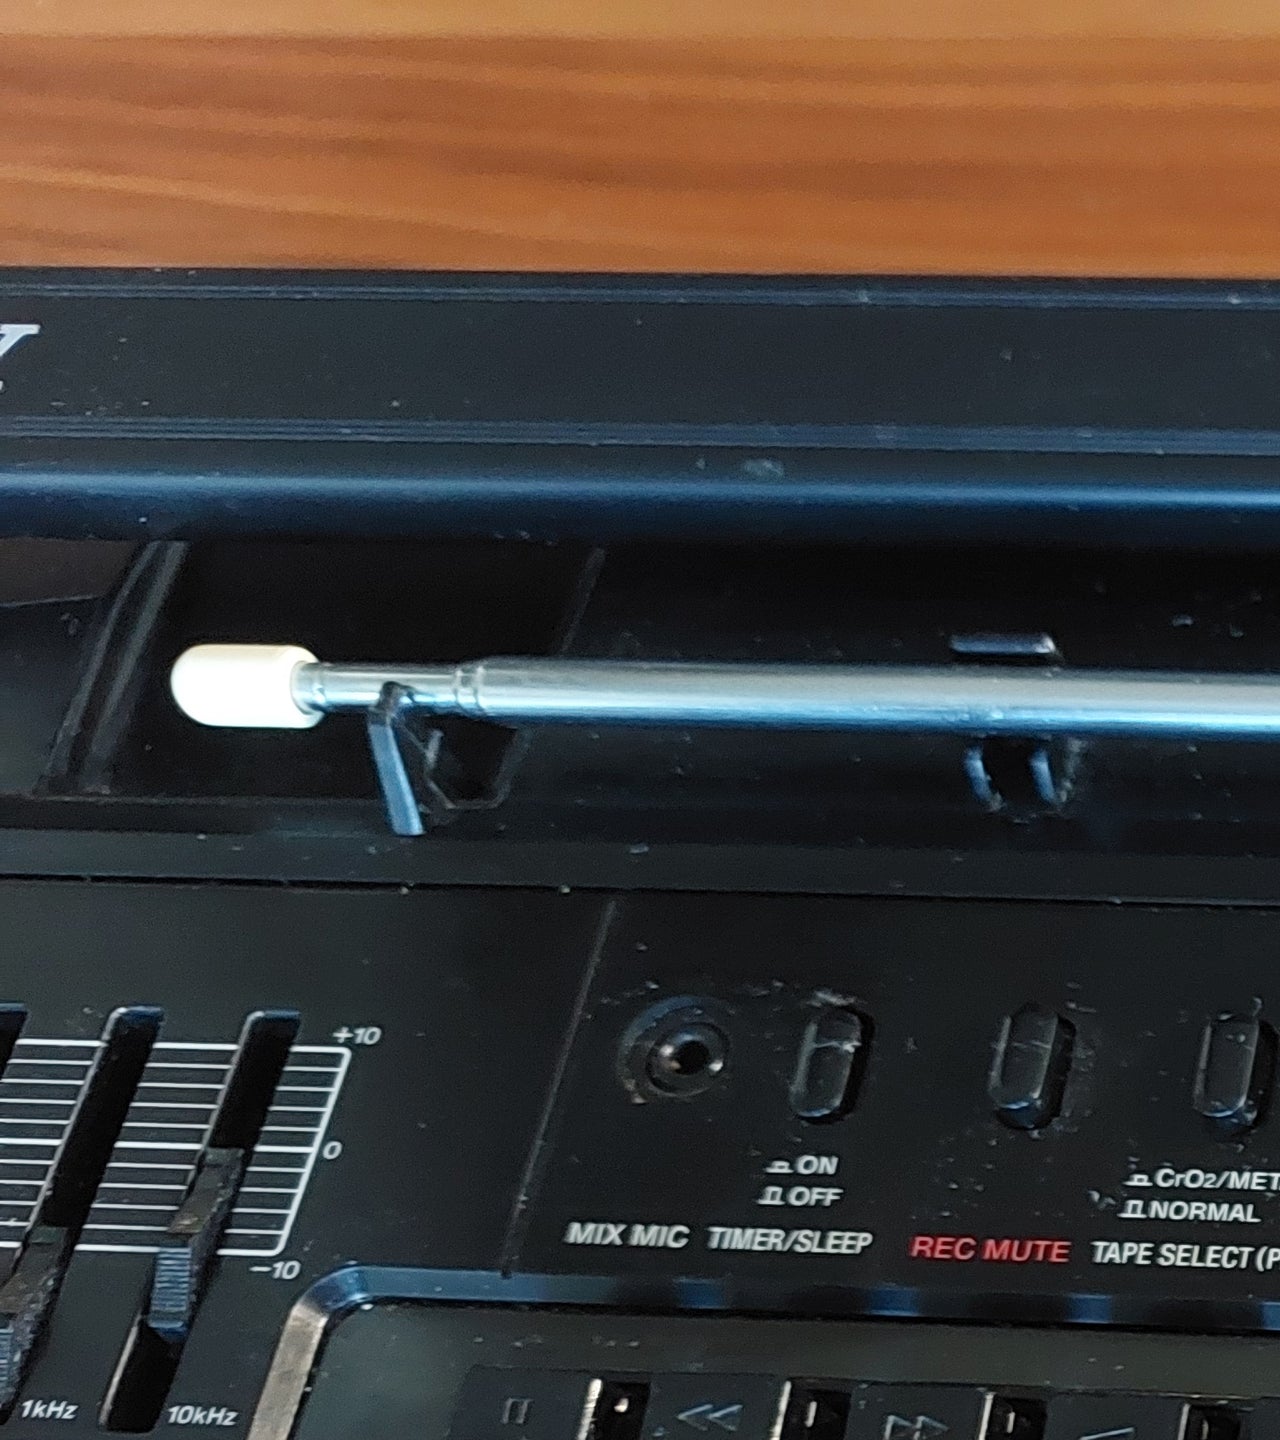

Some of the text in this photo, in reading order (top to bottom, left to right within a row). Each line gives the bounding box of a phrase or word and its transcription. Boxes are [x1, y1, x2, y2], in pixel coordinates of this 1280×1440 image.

[333, 1027, 381, 1045] +10
[322, 1141, 342, 1160] 0
[798, 1156, 838, 1175] ON
[786, 1187, 843, 1207] OFF
[1148, 1201, 1261, 1223] NORMAL
[565, 1222, 690, 1249] MIX MIC
[706, 1227, 873, 1255] TIMER/SLEEP
[910, 1236, 1072, 1263] REC MUTE
[1092, 1241, 1152, 1265] TAPE
[21, 1400, 79, 1419] 1kHz
[168, 1406, 239, 1426] 10kHz
